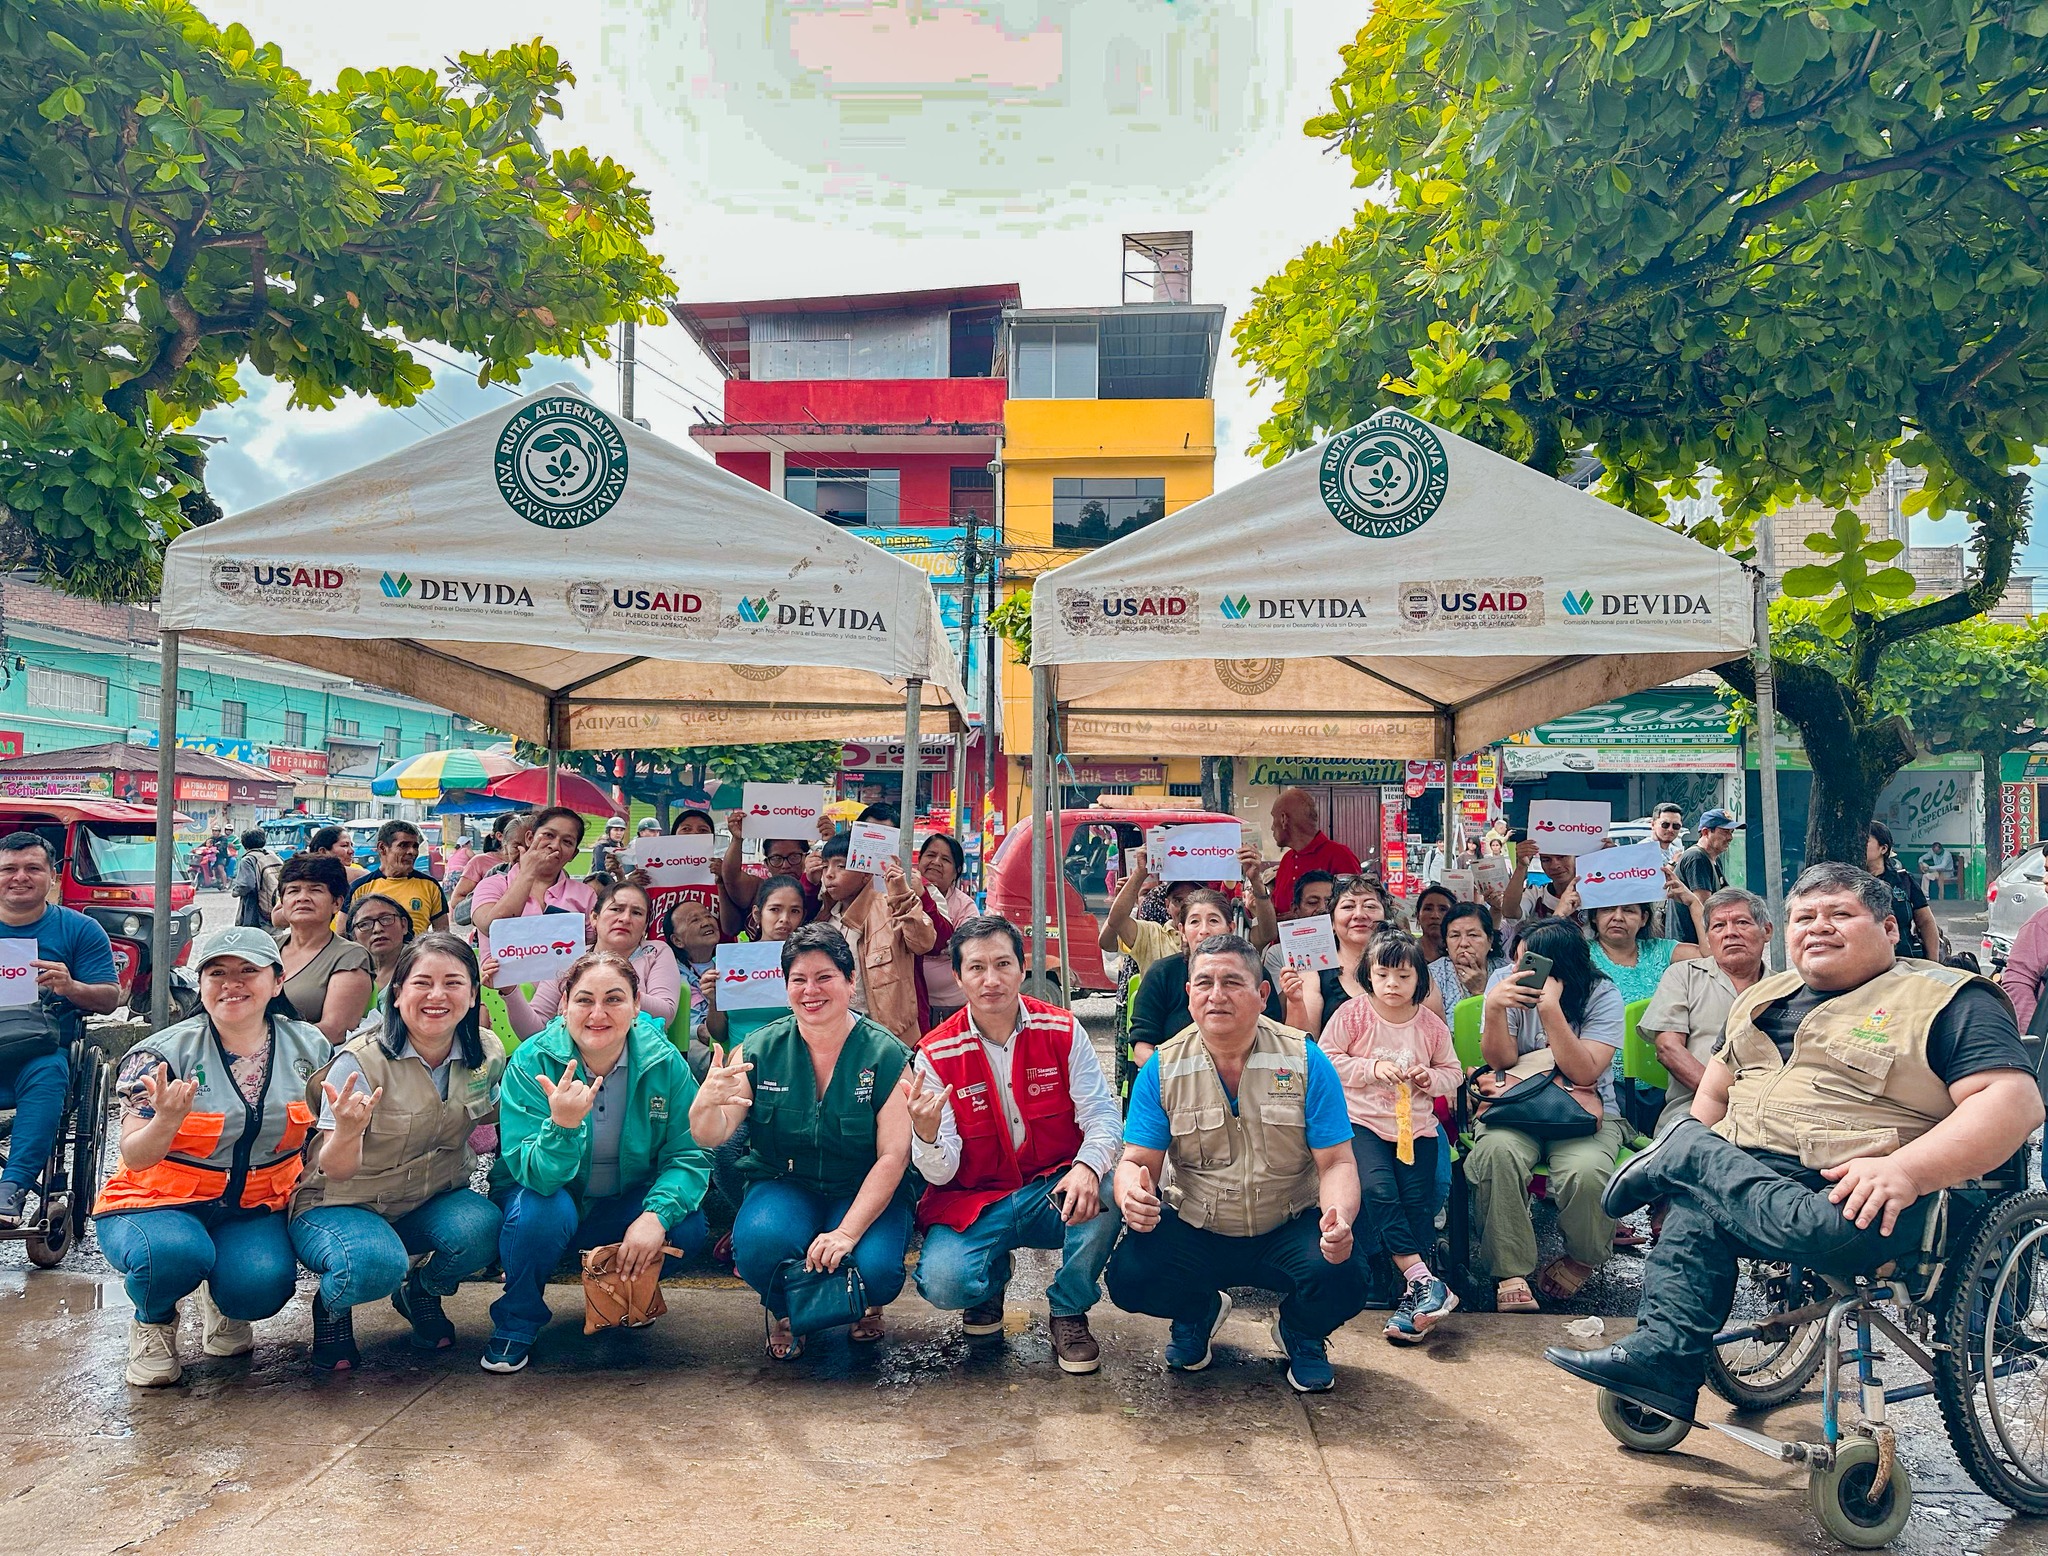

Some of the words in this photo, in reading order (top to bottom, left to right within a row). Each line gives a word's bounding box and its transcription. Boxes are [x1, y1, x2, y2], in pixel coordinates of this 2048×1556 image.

[500, 416, 532, 455] RUTA
[535, 401, 623, 461] ALTERNATIVA
[1325, 434, 1353, 471] RUTA
[1356, 415, 1442, 467] ALTERNATIVA
[886, 536, 932, 548] DENTAL
[254, 566, 343, 589] USAID
[420, 579, 534, 607] DEVIDA
[613, 589, 702, 613] USAID
[1103, 597, 1187, 617] USAID
[1441, 592, 1528, 612] USAID
[1601, 594, 1711, 615] DEVIDA
[408, 603, 433, 611] Nacional
[455, 606, 483, 614] Desarrollo
[625, 611, 649, 619] PUEBLO
[1258, 599, 1366, 618] DEVIDA
[660, 621, 688, 629] AMÉRICA
[778, 604, 887, 632] DEVIDA
[1692, 618, 1712, 626] Drogas
[811, 630, 839, 638] Desarrollo
[1603, 721, 1700, 733] EXCLUSIVA
[888, 744, 946, 755] Corcial
[271, 755, 327, 770] VETERINARIA
[1114, 769, 1131, 782] EL
[1139, 768, 1161, 781] SOL
[1250, 764, 1294, 785] Las
[1302, 765, 1404, 782] Maravill
[6, 782, 36, 796] Betty
[141, 778, 159, 792] ¡PÍD
[182, 781, 191, 789] LA
[191, 782, 207, 790] FIBRA
[208, 782, 227, 791] ÓPTICA
[191, 790, 199, 798] DE
[200, 790, 218, 799] CLARO
[1899, 779, 1959, 822] Seis
[773, 805, 816, 818] contigo
[1917, 802, 1955, 828] ESPECIAL
[2018, 786, 2032, 850] AGUAYT
[1558, 822, 1603, 835] contigo
[2001, 784, 2016, 862] PUCALLPA
[1190, 845, 1235, 859] contigo
[665, 855, 708, 867] contigo
[1388, 872, 1403, 884] 20
[1608, 867, 1656, 881] contigo
[498, 944, 549, 960] contigo
[0, 965, 27, 980] igo
[751, 966, 784, 980] conti
